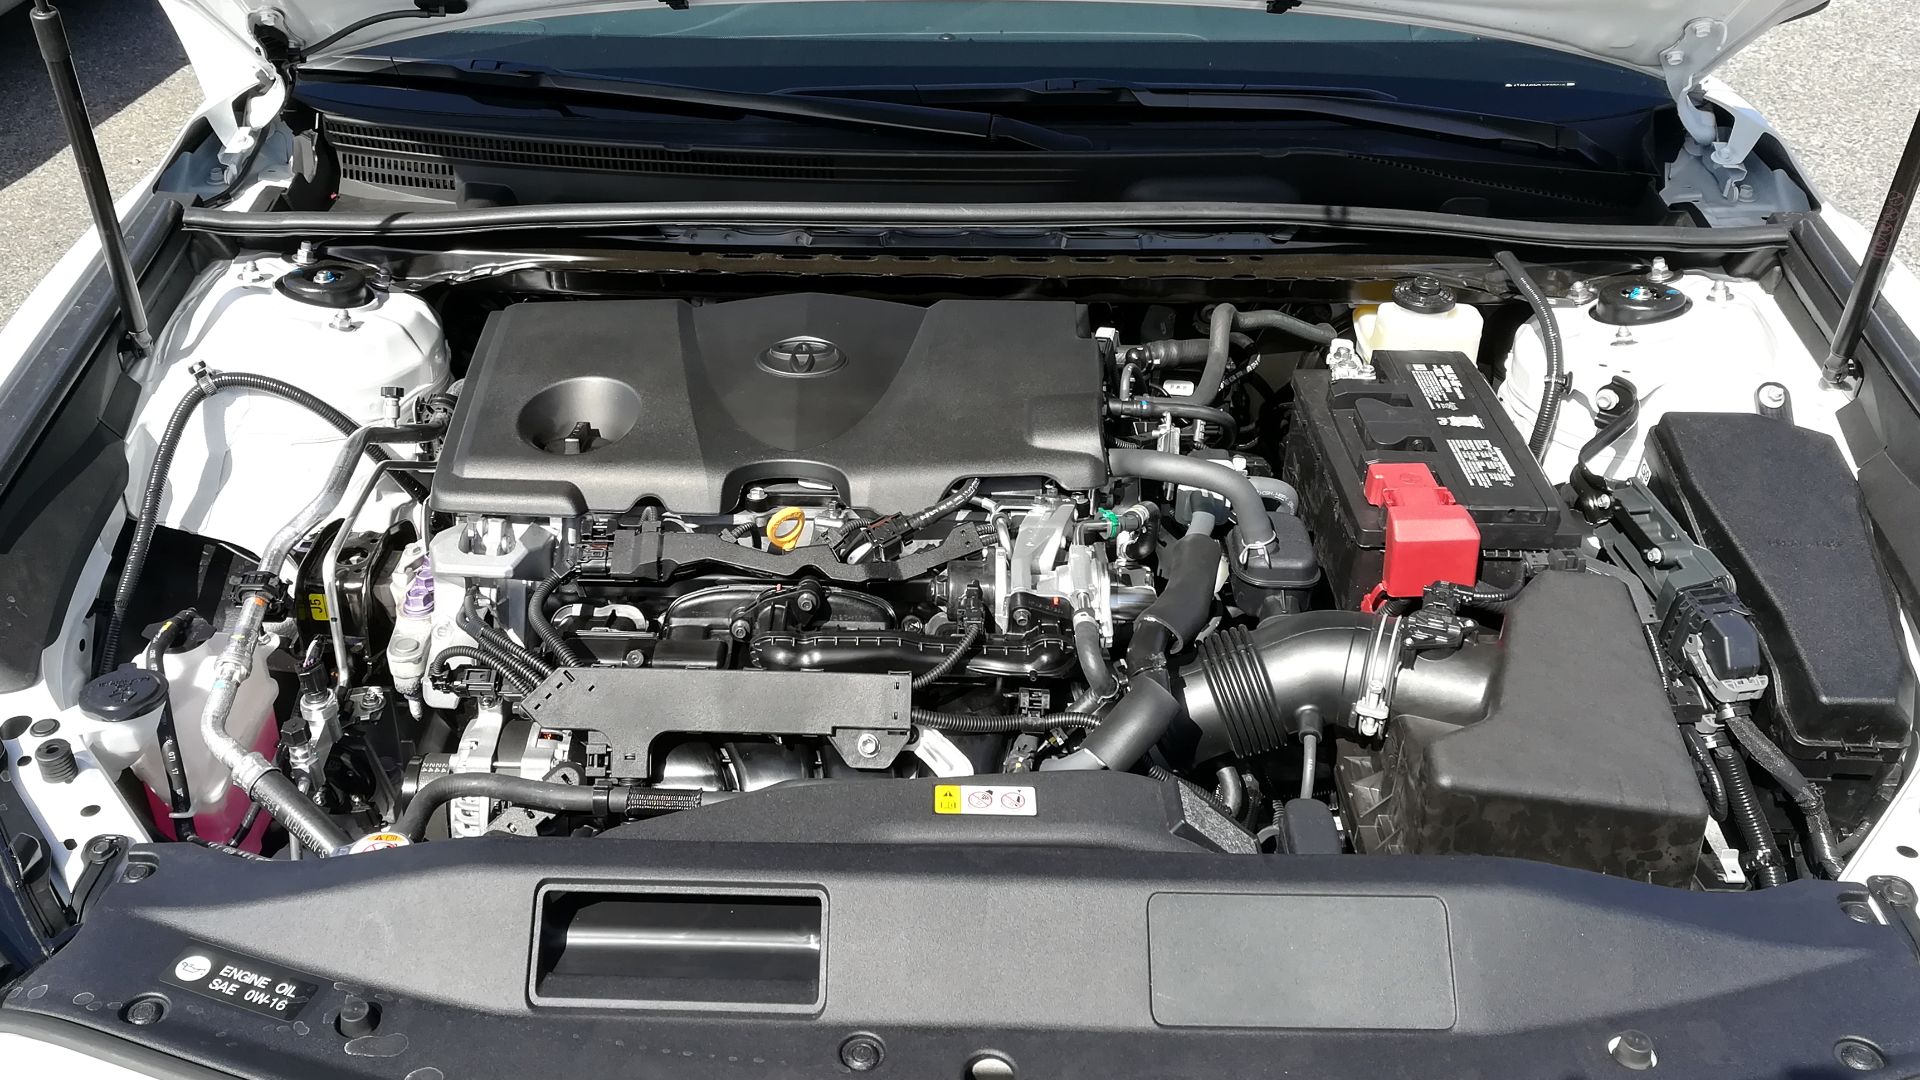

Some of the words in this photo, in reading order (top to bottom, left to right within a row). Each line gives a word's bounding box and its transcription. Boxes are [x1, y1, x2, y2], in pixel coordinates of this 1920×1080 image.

[208, 978, 240, 996] SAE
[243, 989, 288, 1011] 0W-16
[219, 965, 272, 989] ENGINE
[275, 982, 298, 998] OIL
